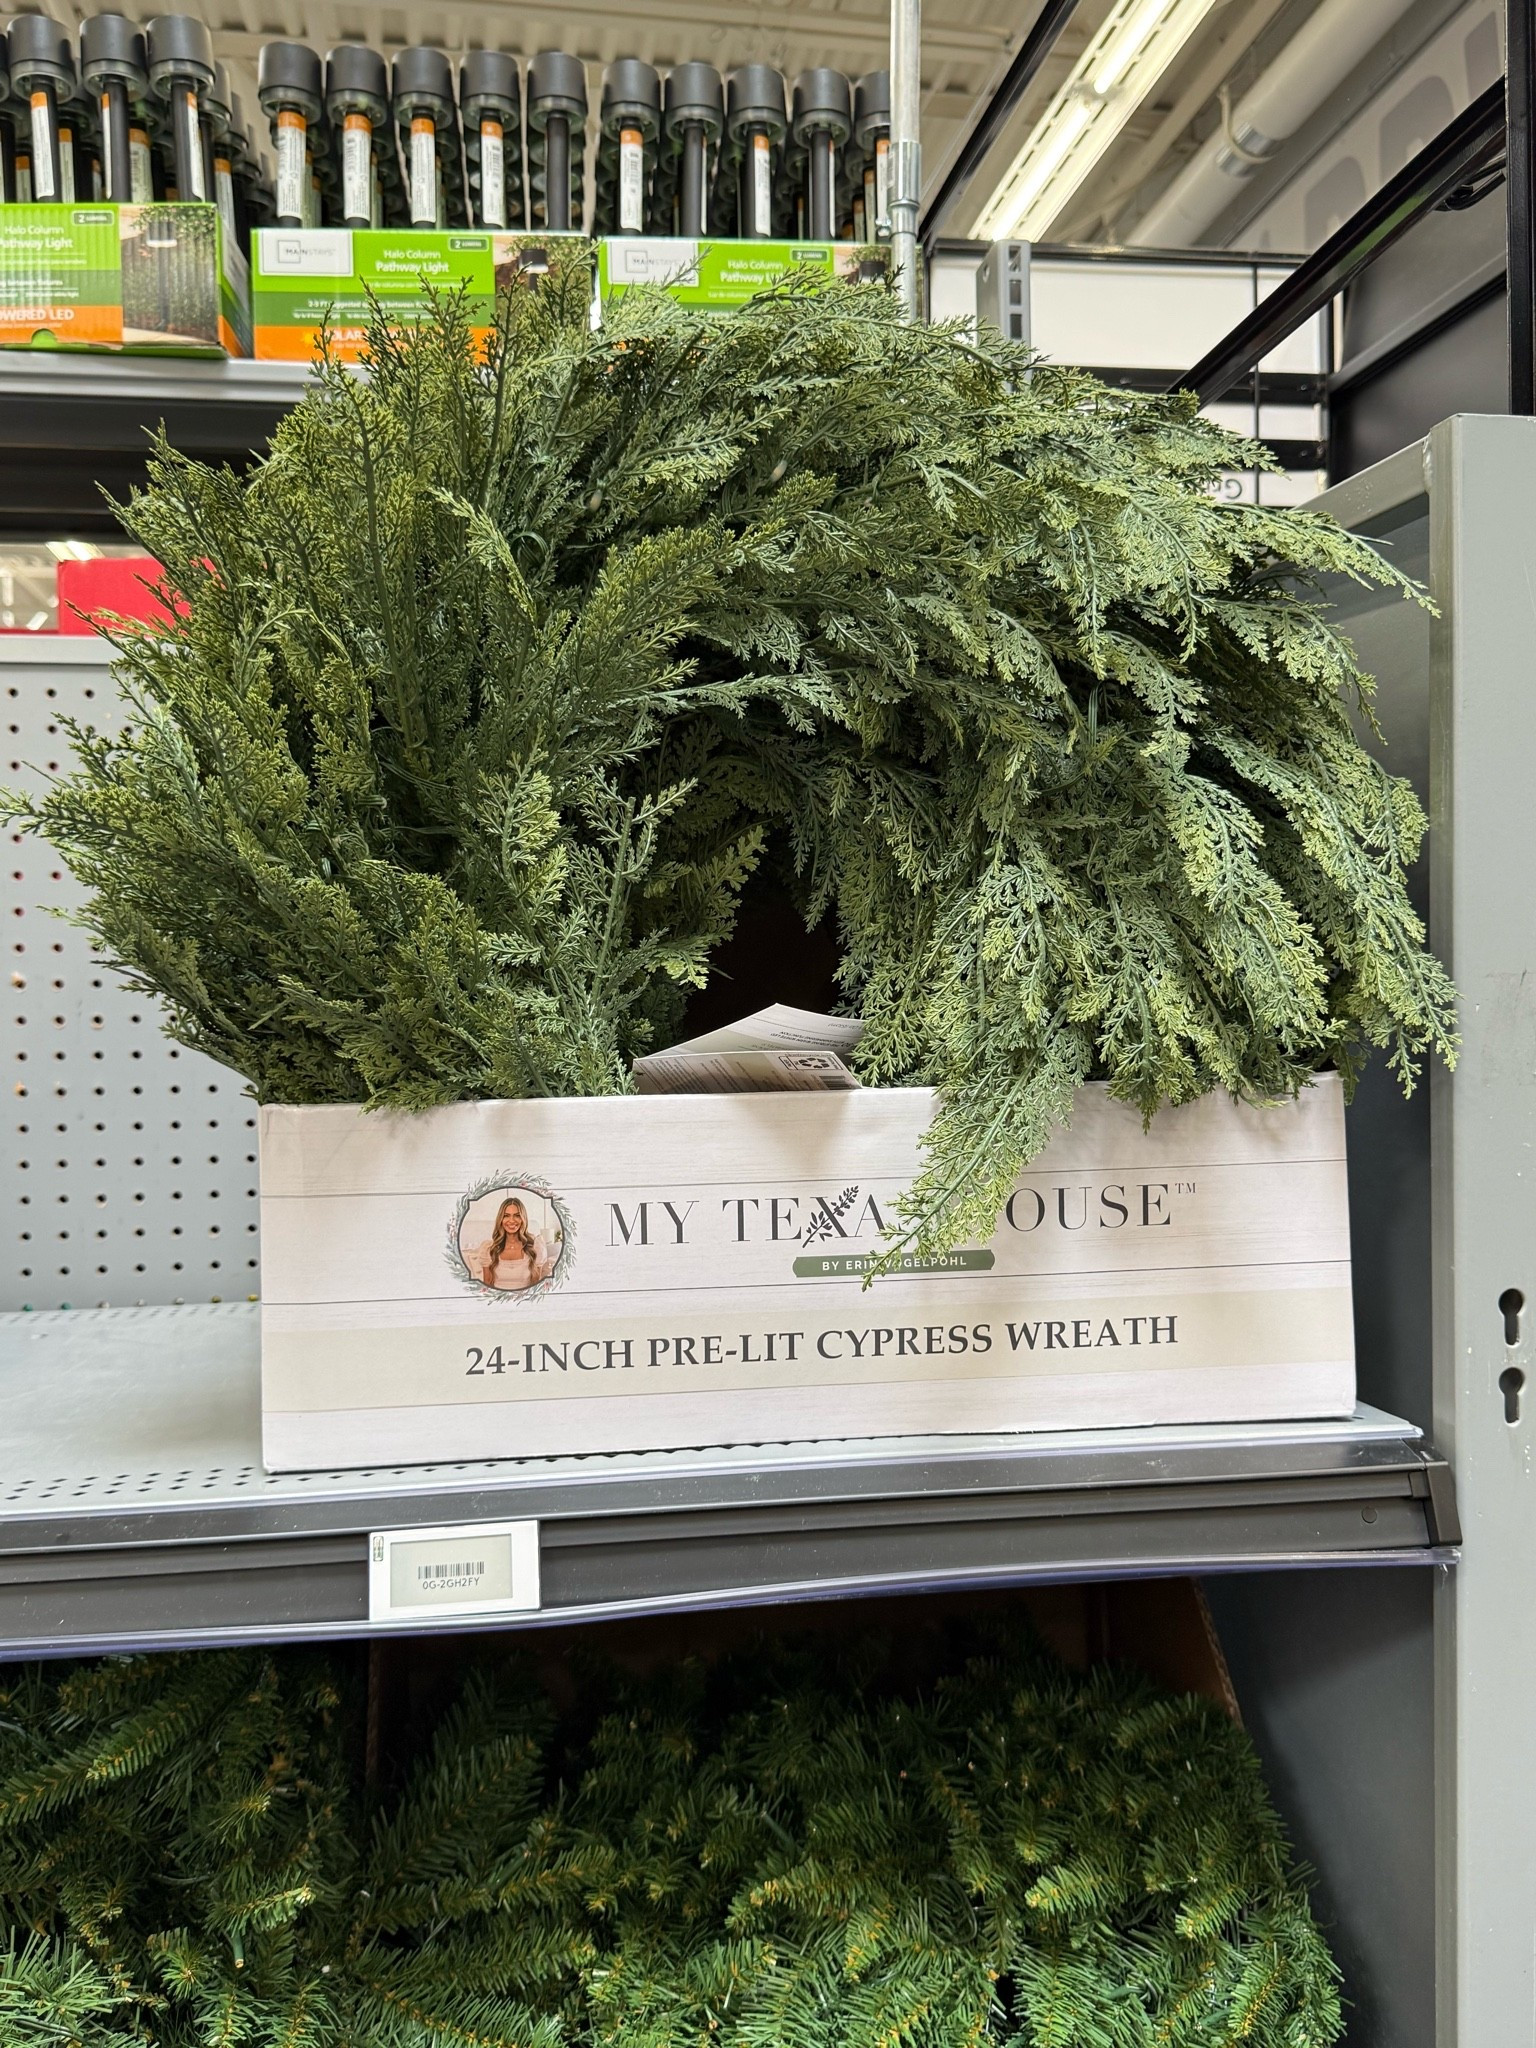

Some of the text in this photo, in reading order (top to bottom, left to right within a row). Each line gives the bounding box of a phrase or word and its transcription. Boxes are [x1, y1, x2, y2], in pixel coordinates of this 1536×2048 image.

[78, 214, 85, 223] 2
[4, 225, 65, 234] Halo Column
[0, 237, 74, 251] athway Light
[454, 240, 461, 249] 2
[383, 249, 441, 259] Halo Column
[796, 251, 803, 260] 2
[375, 260, 450, 275] Pathway Light
[727, 260, 783, 270] Halo Column
[720, 271, 764, 285] Pathway
[49, 309, 75, 321] LED
[604, 1200, 700, 1247] MY
[722, 1193, 905, 1243] TEXA
[822, 1260, 840, 1271] BY
[465, 1315, 1179, 1376] 24-INCH PRE-LIT CYPRESS WREATH
